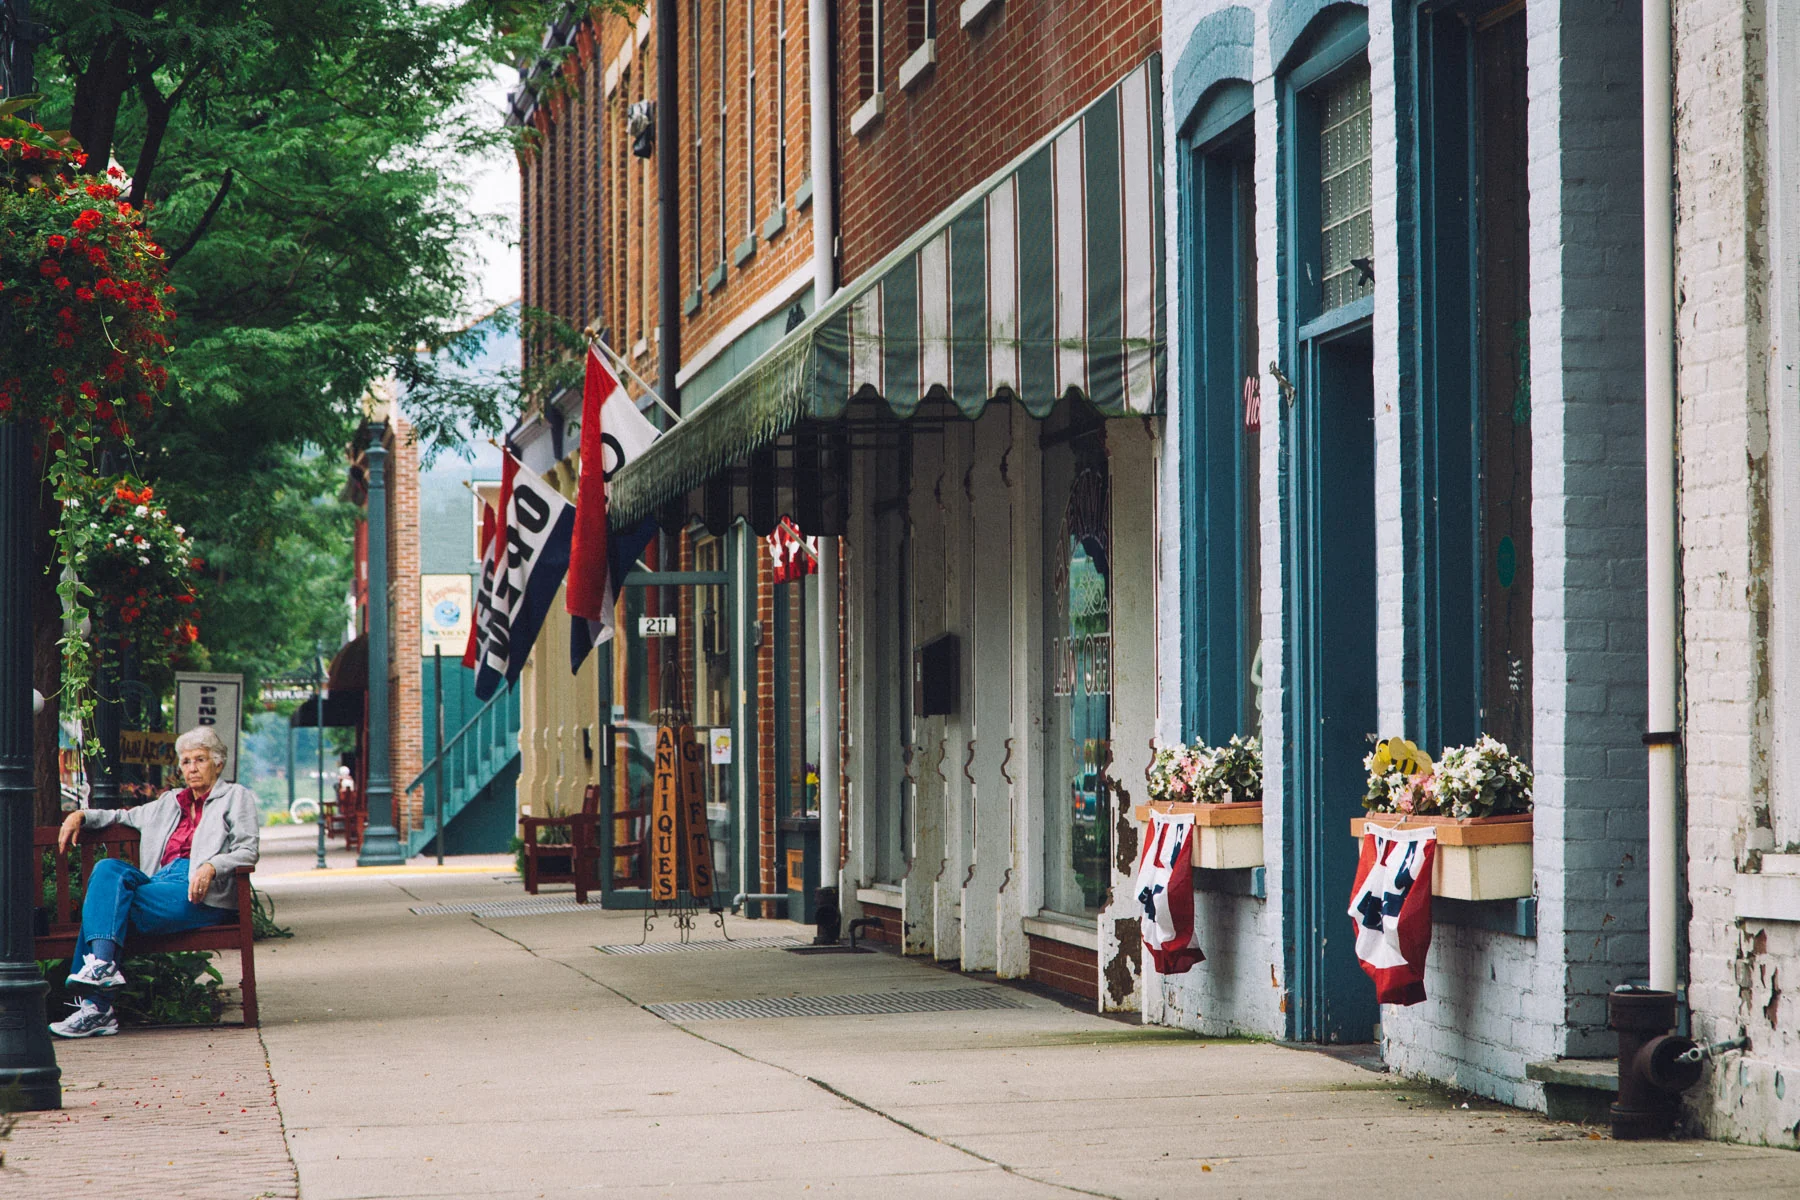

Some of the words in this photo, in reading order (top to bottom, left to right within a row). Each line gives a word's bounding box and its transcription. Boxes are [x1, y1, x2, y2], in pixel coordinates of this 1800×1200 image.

[646, 618, 668, 632] 211
[1054, 635, 1079, 696] LAW
[657, 731, 673, 896] ANTIQUES
[683, 741, 709, 887] GIFTS
